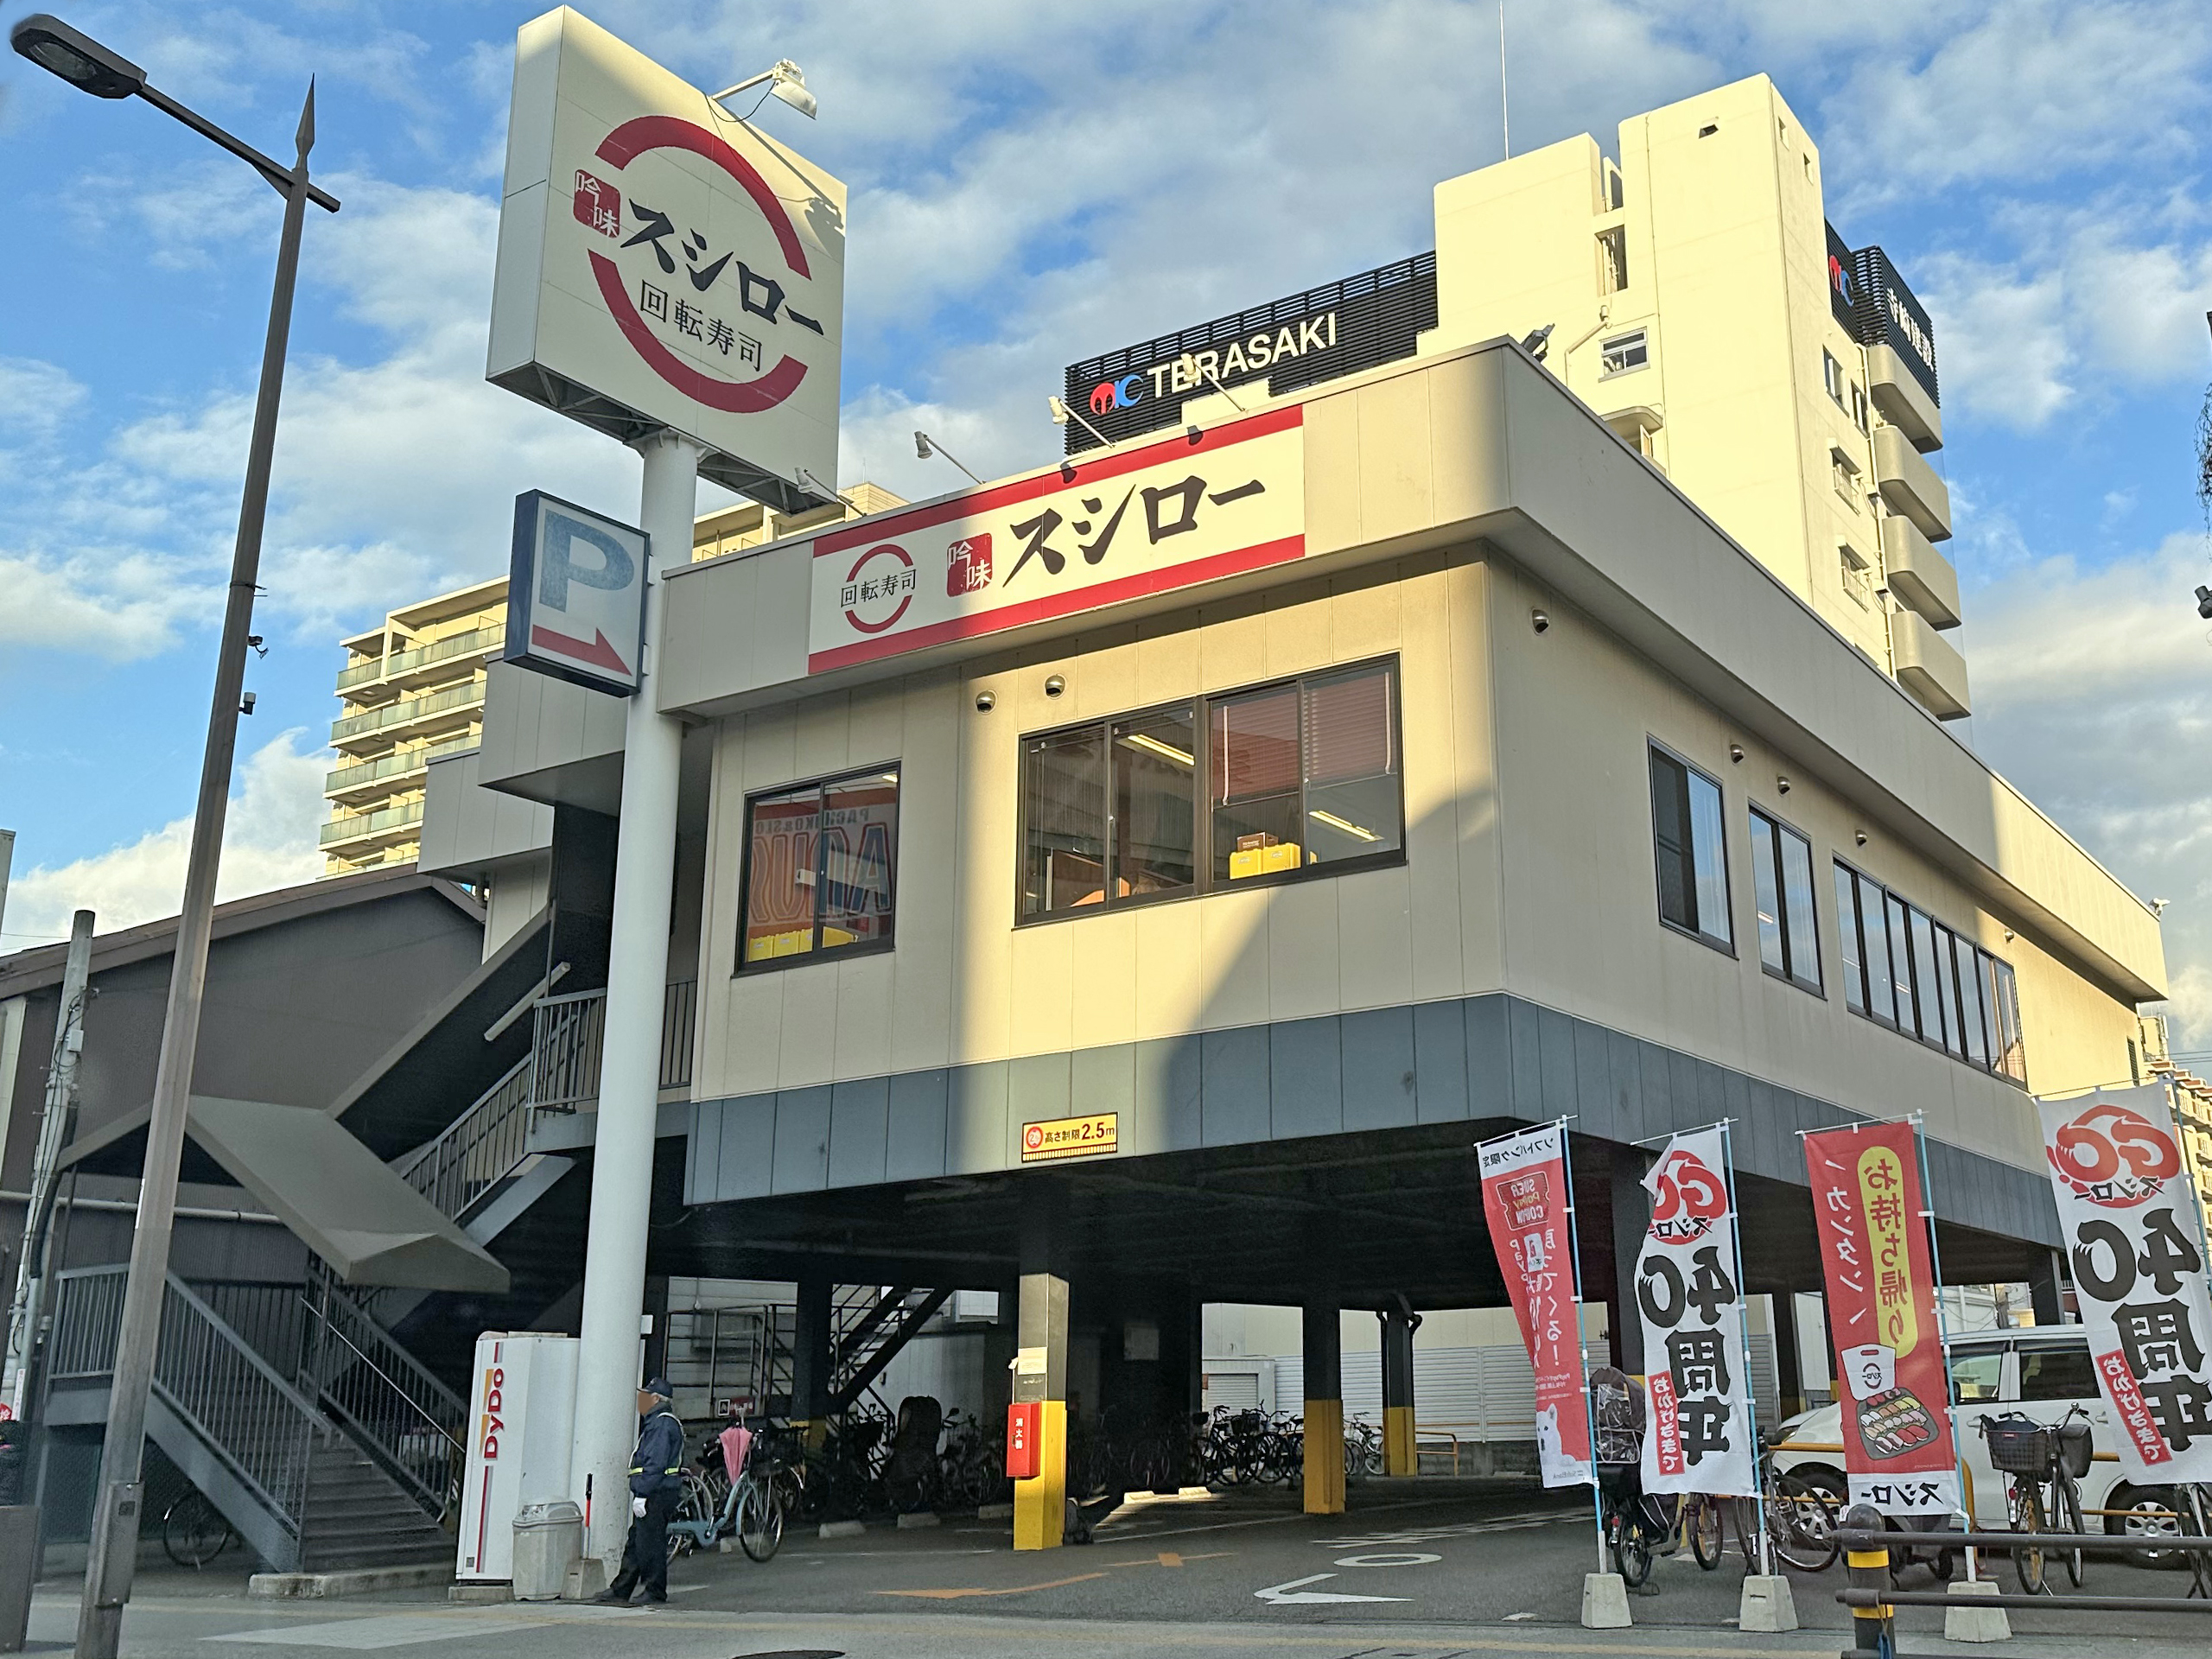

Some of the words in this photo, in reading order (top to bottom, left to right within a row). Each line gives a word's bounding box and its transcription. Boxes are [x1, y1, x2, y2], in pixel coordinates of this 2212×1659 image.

[575, 171, 620, 237] 吟味
[620, 198, 824, 336] スシロー
[640, 280, 763, 372] 回転寿司
[1147, 312, 1337, 398] TERASAKI
[539, 508, 635, 613] P
[948, 543, 992, 593] 吟味
[1003, 475, 1266, 588] スシロー
[840, 569, 917, 608] 回転寿司
